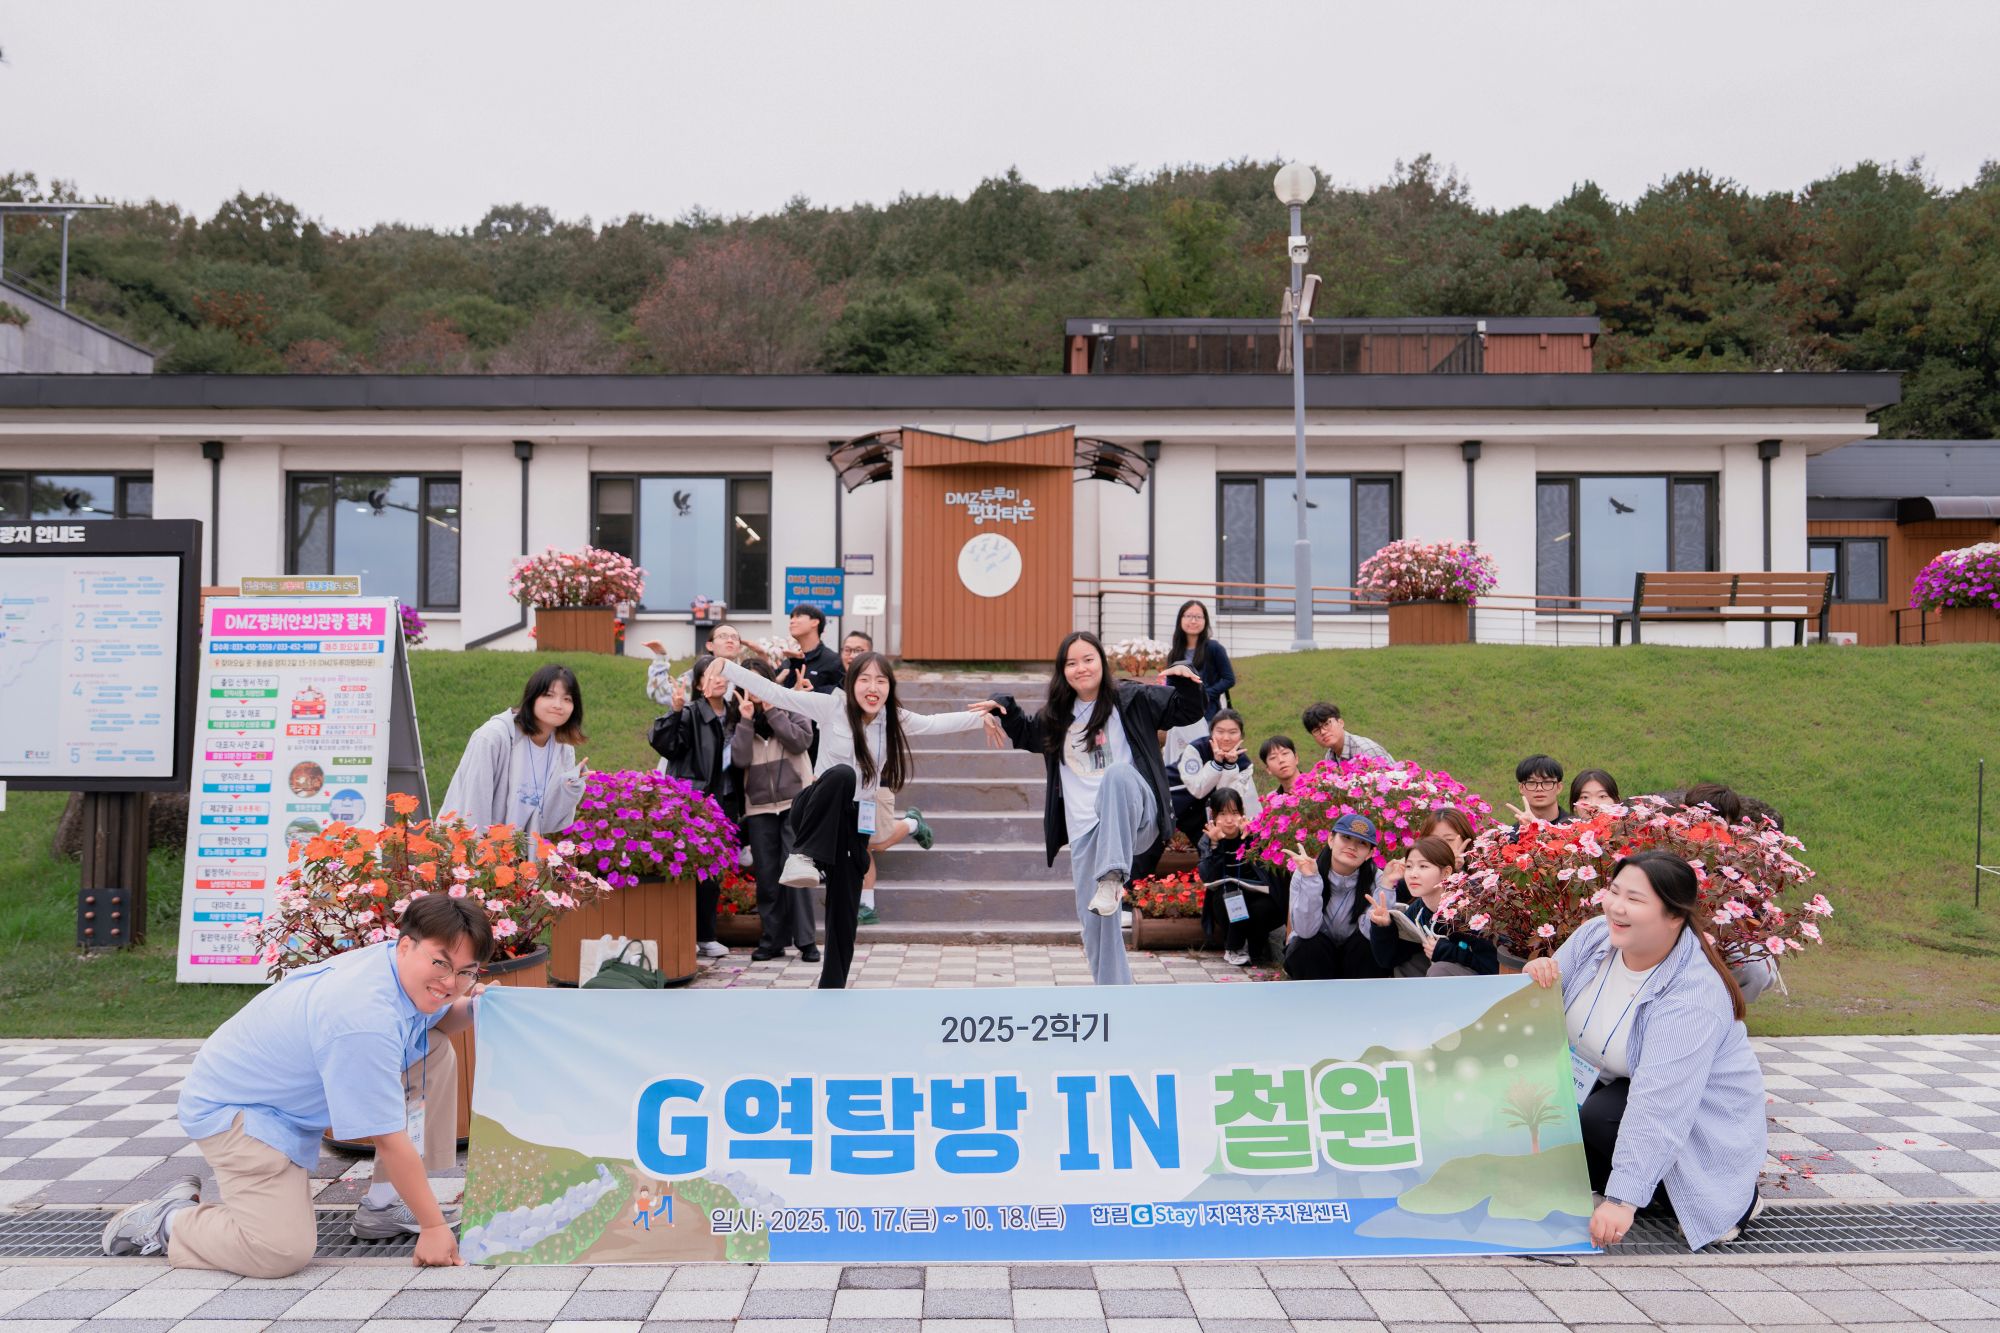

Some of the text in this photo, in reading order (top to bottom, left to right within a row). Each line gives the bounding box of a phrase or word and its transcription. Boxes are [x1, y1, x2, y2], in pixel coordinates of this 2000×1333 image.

[945, 487, 1020, 505] DMZ두루미
[967, 499, 1035, 525] 평화타운
[35, 526, 86, 544] 안내도
[225, 612, 373, 631] DMZ평화(안보)관광 절차
[226, 709, 261, 718] 접수 및 매표
[288, 725, 319, 735] 제2땅굴
[216, 740, 265, 749] 대표자 사전 교육
[221, 773, 256, 782] 양지리 초소
[210, 804, 234, 813] 제2땅굴
[217, 836, 251, 846] 평화전망대
[211, 902, 247, 910] 대마리 초소
[941, 1013, 1109, 1043] 2025-2학기
[637, 1067, 1415, 1175] G역탐방 IN 철원
[711, 1209, 763, 1234] 일시:
[771, 1209, 829, 1231] 2025.
[838, 1210, 867, 1231] 10.
[873, 1208, 938, 1233] 17.(금)
[966, 1209, 995, 1230] 10.
[1002, 1206, 1066, 1231] 18.(토)
[1092, 1205, 1128, 1225] 한림
[1207, 1203, 1350, 1224] 지역정주지원센터
